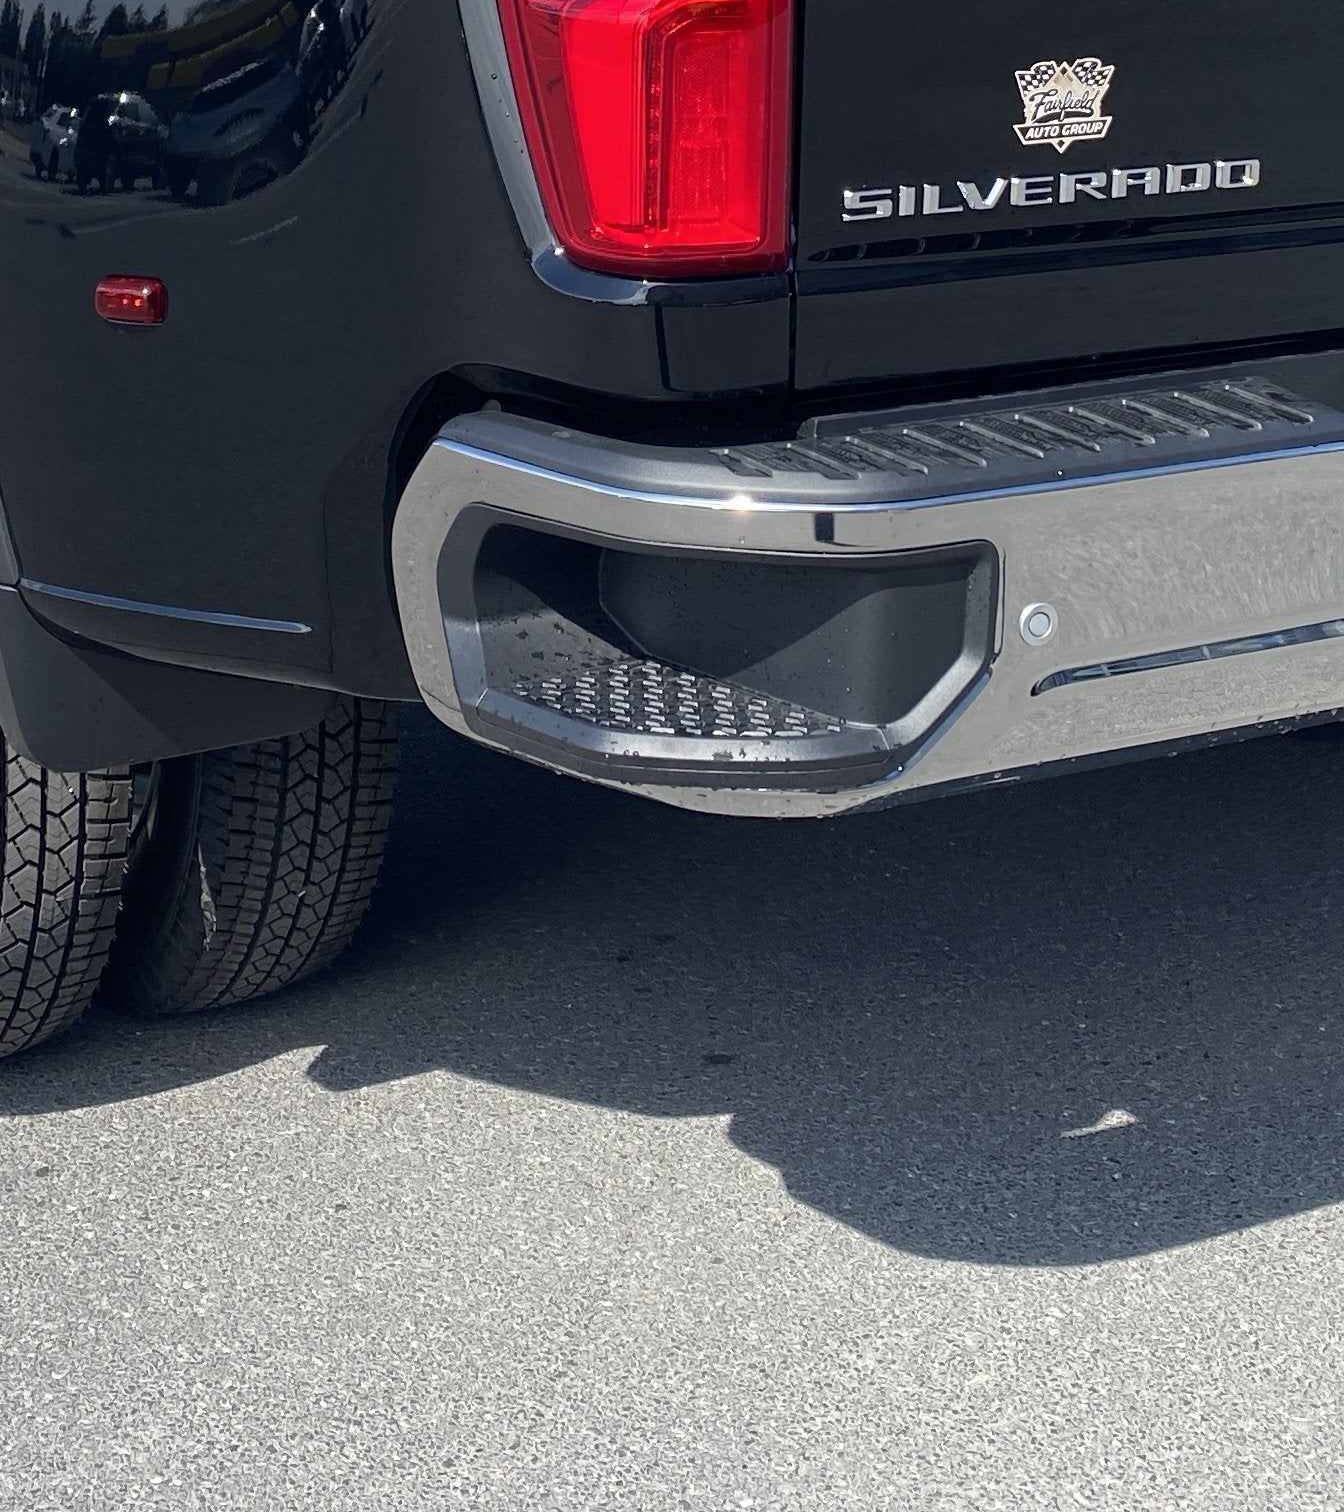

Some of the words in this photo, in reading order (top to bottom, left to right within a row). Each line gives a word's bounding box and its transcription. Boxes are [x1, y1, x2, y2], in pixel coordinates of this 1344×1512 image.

[1028, 88, 1100, 122] Fairfield
[1024, 125, 1060, 140] AUTO
[1061, 121, 1104, 137] GROUP
[840, 156, 1262, 224] SILVERADO
